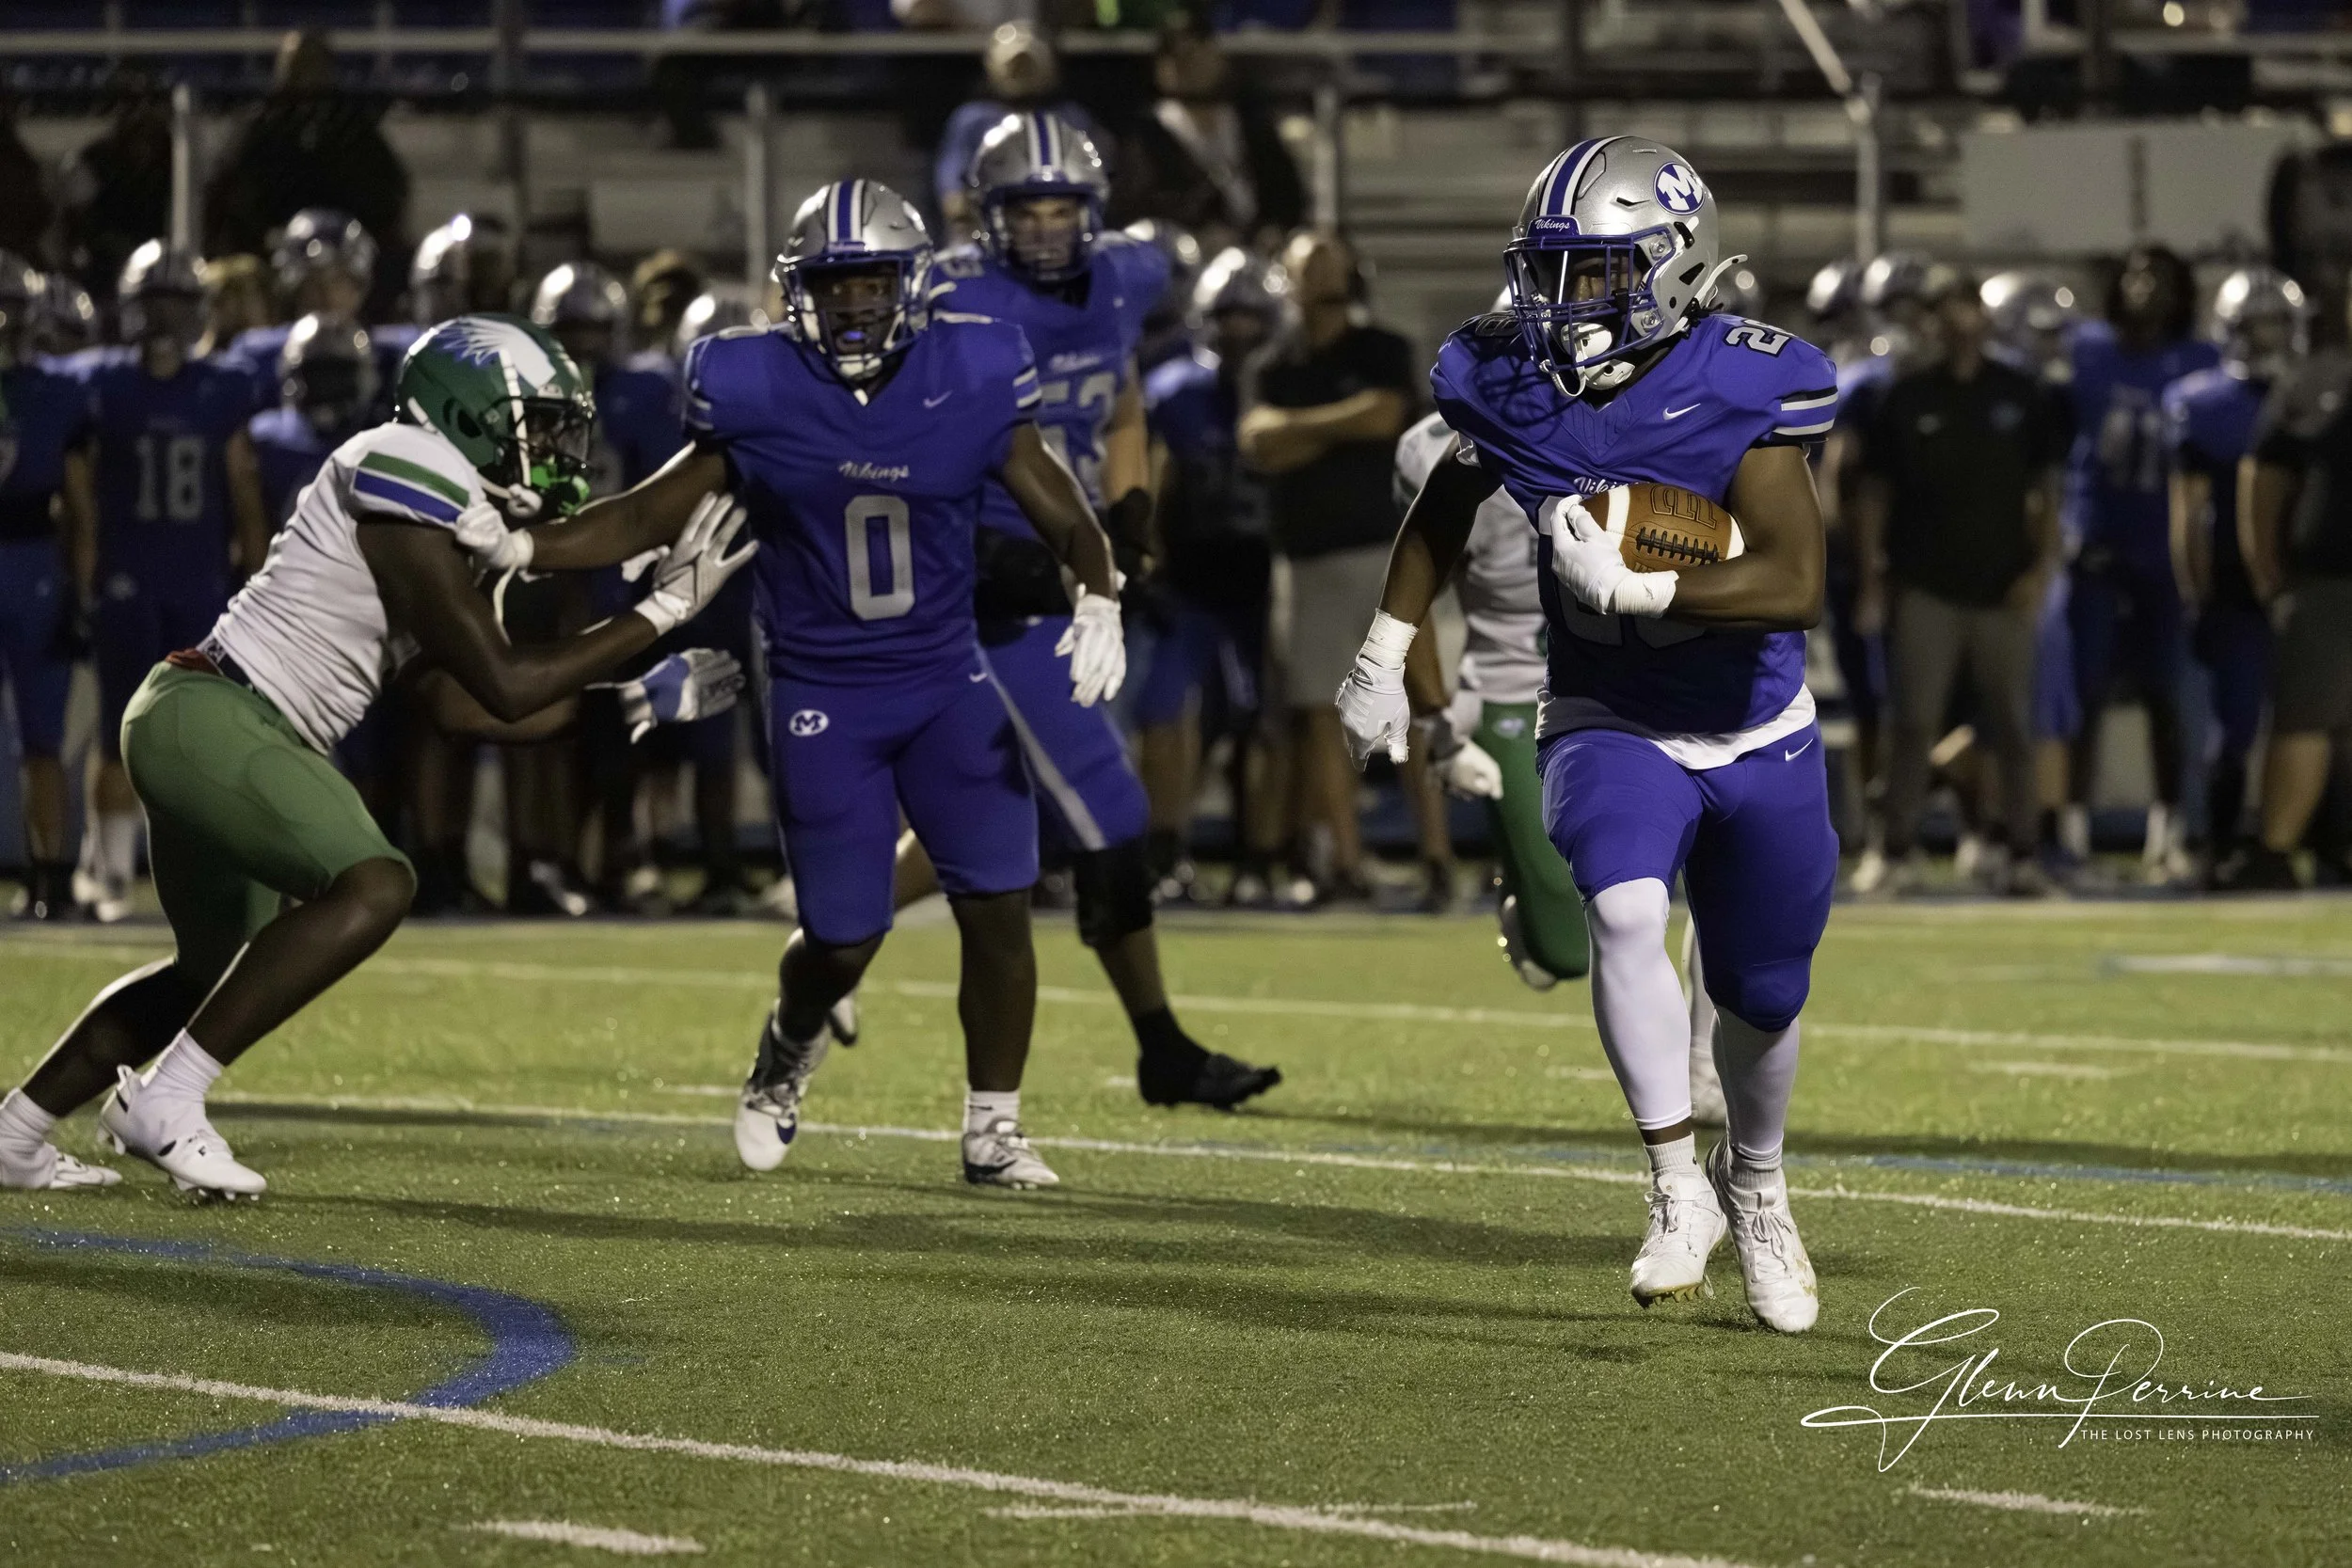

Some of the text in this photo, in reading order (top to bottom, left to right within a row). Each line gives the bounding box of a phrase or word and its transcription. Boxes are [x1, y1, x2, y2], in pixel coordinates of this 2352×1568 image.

[1655, 162, 1704, 214] M
[1534, 217, 1571, 231] Vikings
[134, 436, 205, 521] 18
[1573, 476, 1643, 494] Viki
[845, 495, 915, 621] 0
[792, 712, 825, 735] M
